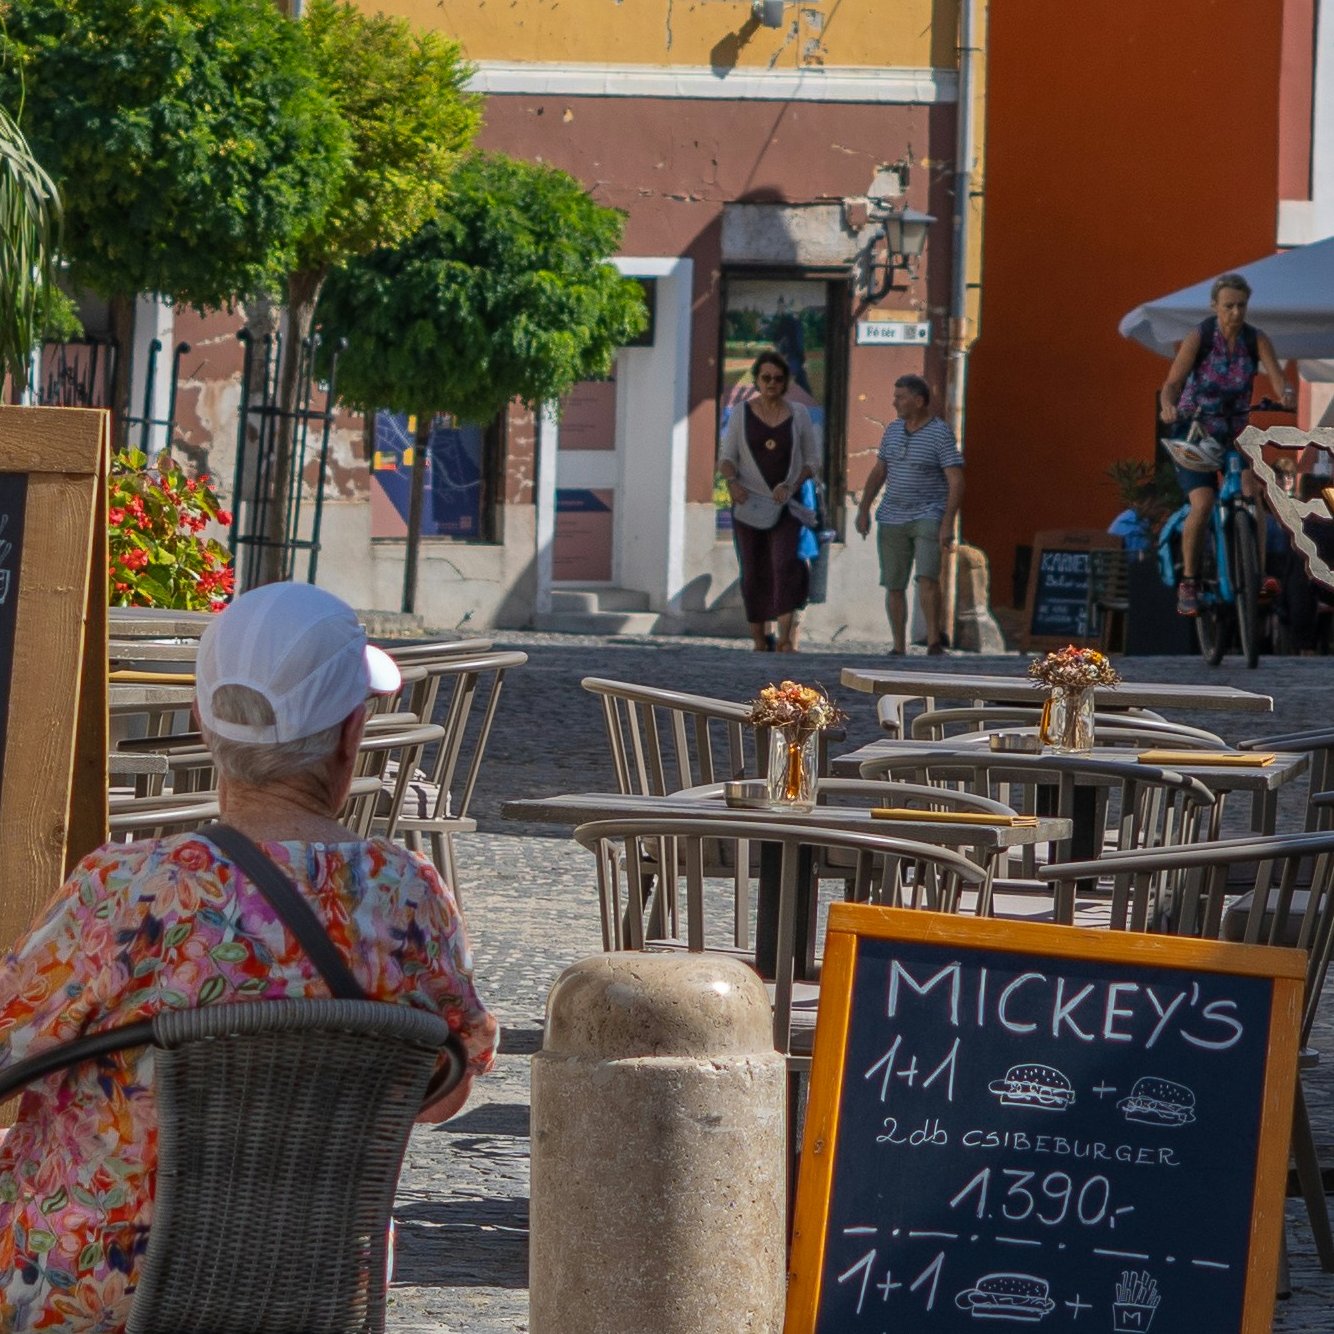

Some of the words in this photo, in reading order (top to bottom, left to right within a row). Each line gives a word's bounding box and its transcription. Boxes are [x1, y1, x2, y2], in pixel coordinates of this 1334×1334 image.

[887, 960, 1245, 1050] MICKEY'S
[864, 1034, 961, 1103] 1+1
[962, 1129, 1181, 1166] CSIBEBURGER
[837, 1248, 945, 1315] 1+1
